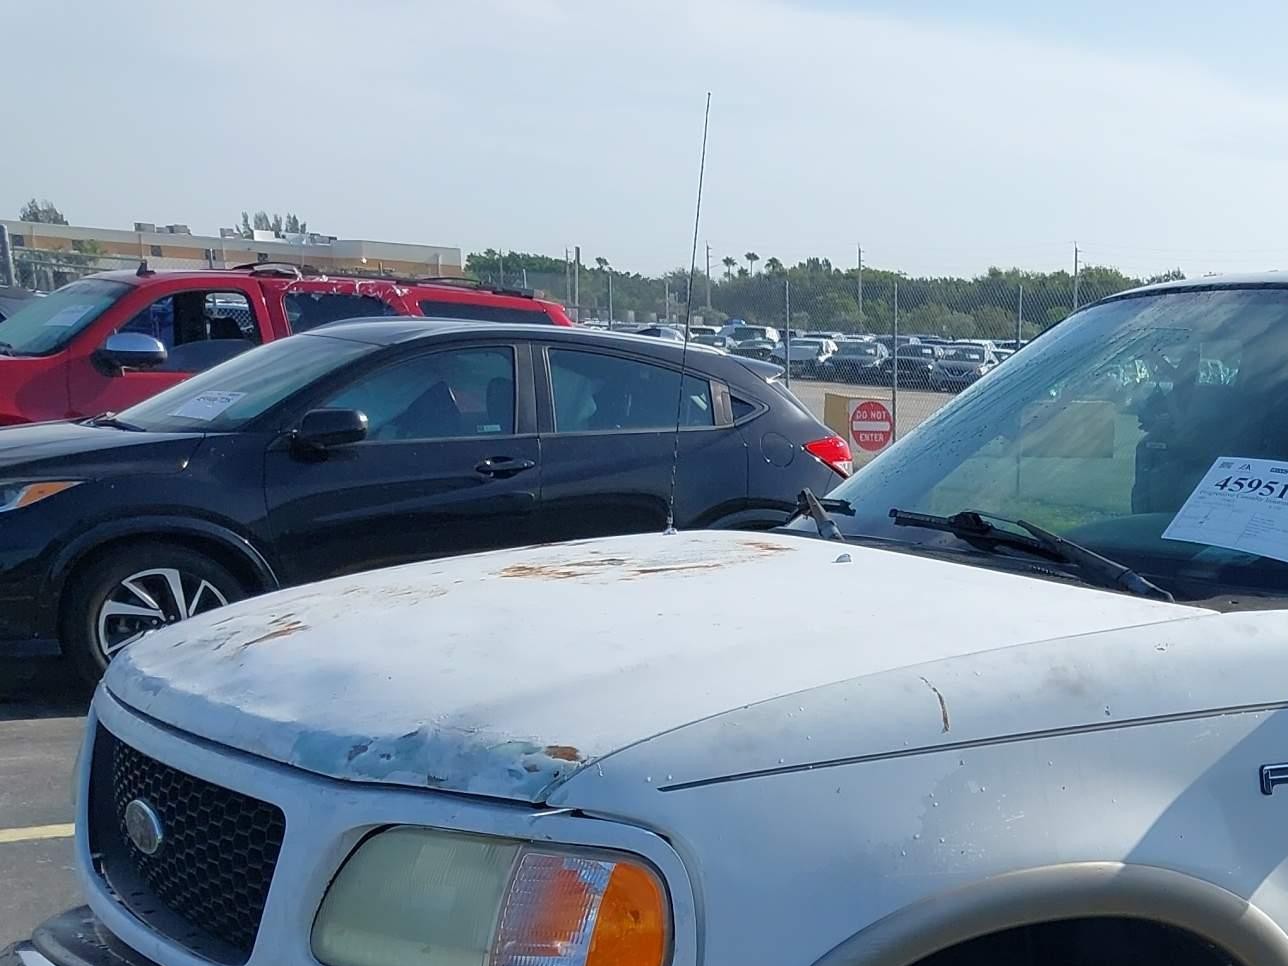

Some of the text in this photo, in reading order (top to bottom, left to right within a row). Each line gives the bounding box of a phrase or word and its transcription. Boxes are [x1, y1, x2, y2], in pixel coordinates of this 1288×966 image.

[856, 411, 886, 419] DO NOT
[859, 433, 884, 442] ENTER
